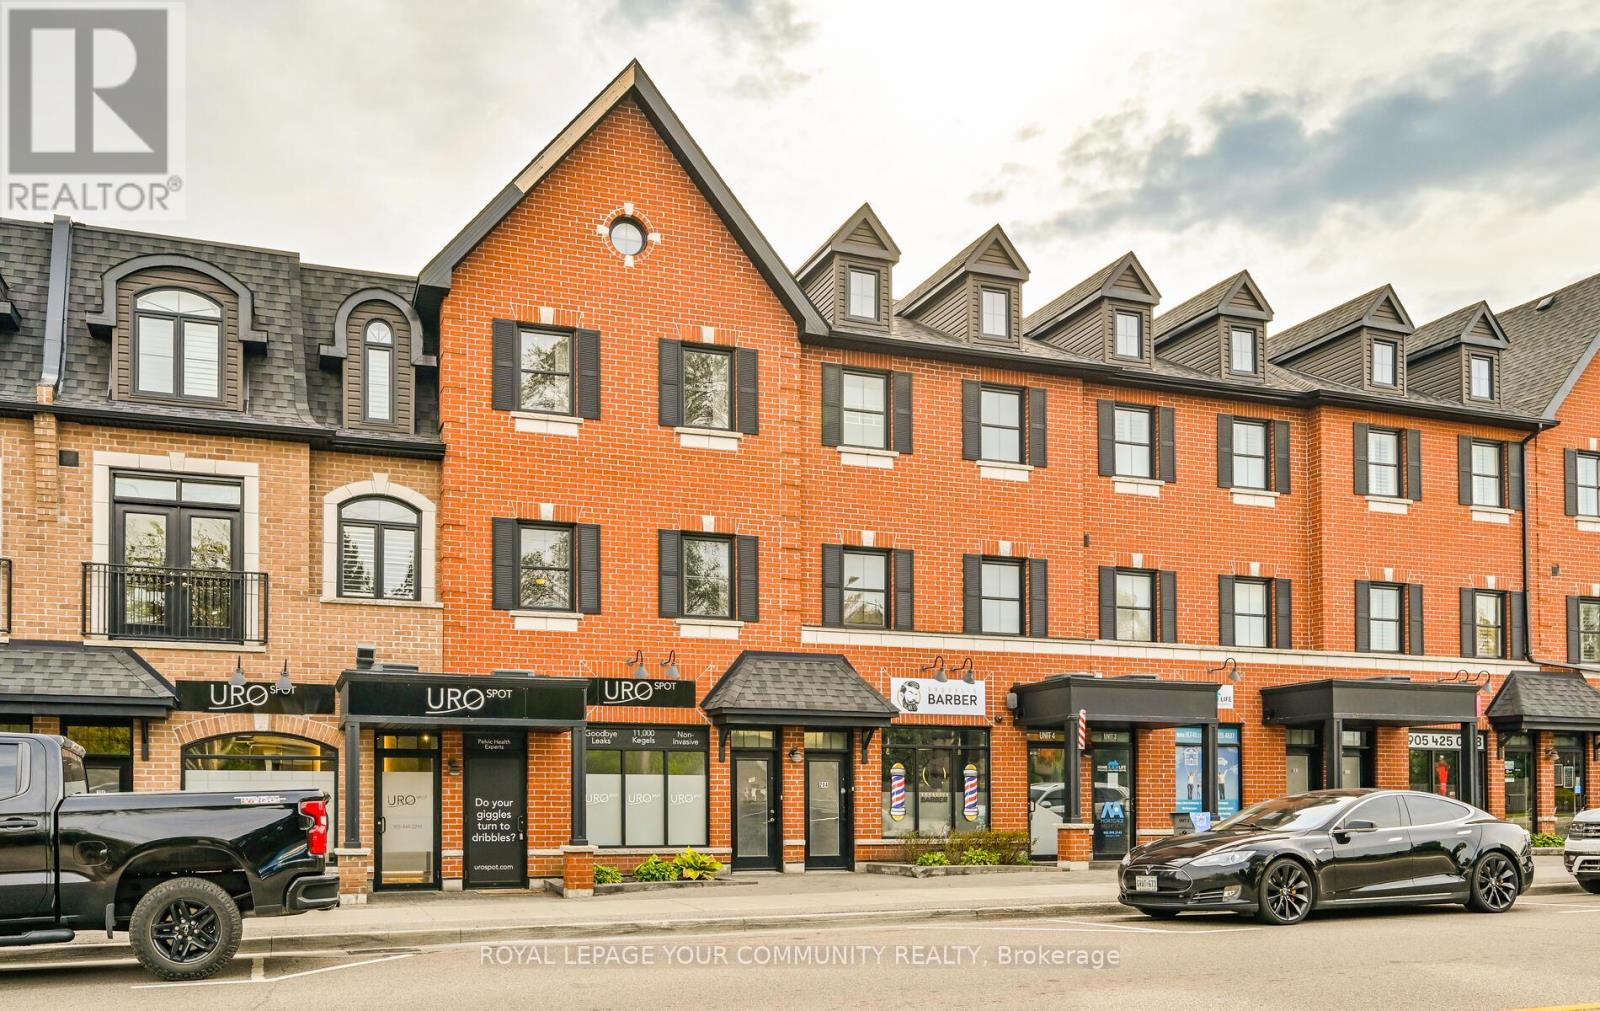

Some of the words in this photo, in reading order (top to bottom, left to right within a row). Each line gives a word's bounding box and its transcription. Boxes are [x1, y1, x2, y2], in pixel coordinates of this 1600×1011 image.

[210, 684, 268, 706] URO
[604, 681, 653, 701] URO
[654, 682, 677, 691] SPOT
[427, 687, 485, 710] URO
[486, 689, 513, 699] SPOT
[928, 694, 978, 706] BARBER
[585, 729, 618, 739] Goodbye
[632, 729, 655, 739] 11,000
[677, 731, 694, 739] Non-
[477, 738, 493, 746] Pelvic
[494, 738, 511, 746] Health
[591, 737, 612, 745] Leaks
[632, 736, 656, 746] Kegels
[672, 738, 699, 746] Invasive
[1408, 735, 1429, 746] 905
[1432, 736, 1453, 747] 425
[1456, 736, 1482, 747] 08
[387, 794, 416, 806] URO
[475, 797, 489, 807] Do
[492, 799, 514, 809] your
[585, 792, 609, 804] URO
[628, 792, 652, 804] URO
[670, 792, 694, 804] URO
[476, 809, 512, 821] giggles
[477, 822, 497, 831] turn
[500, 822, 511, 831] to
[471, 832, 517, 842] dribbles?
[473, 864, 514, 872] urospot.com
